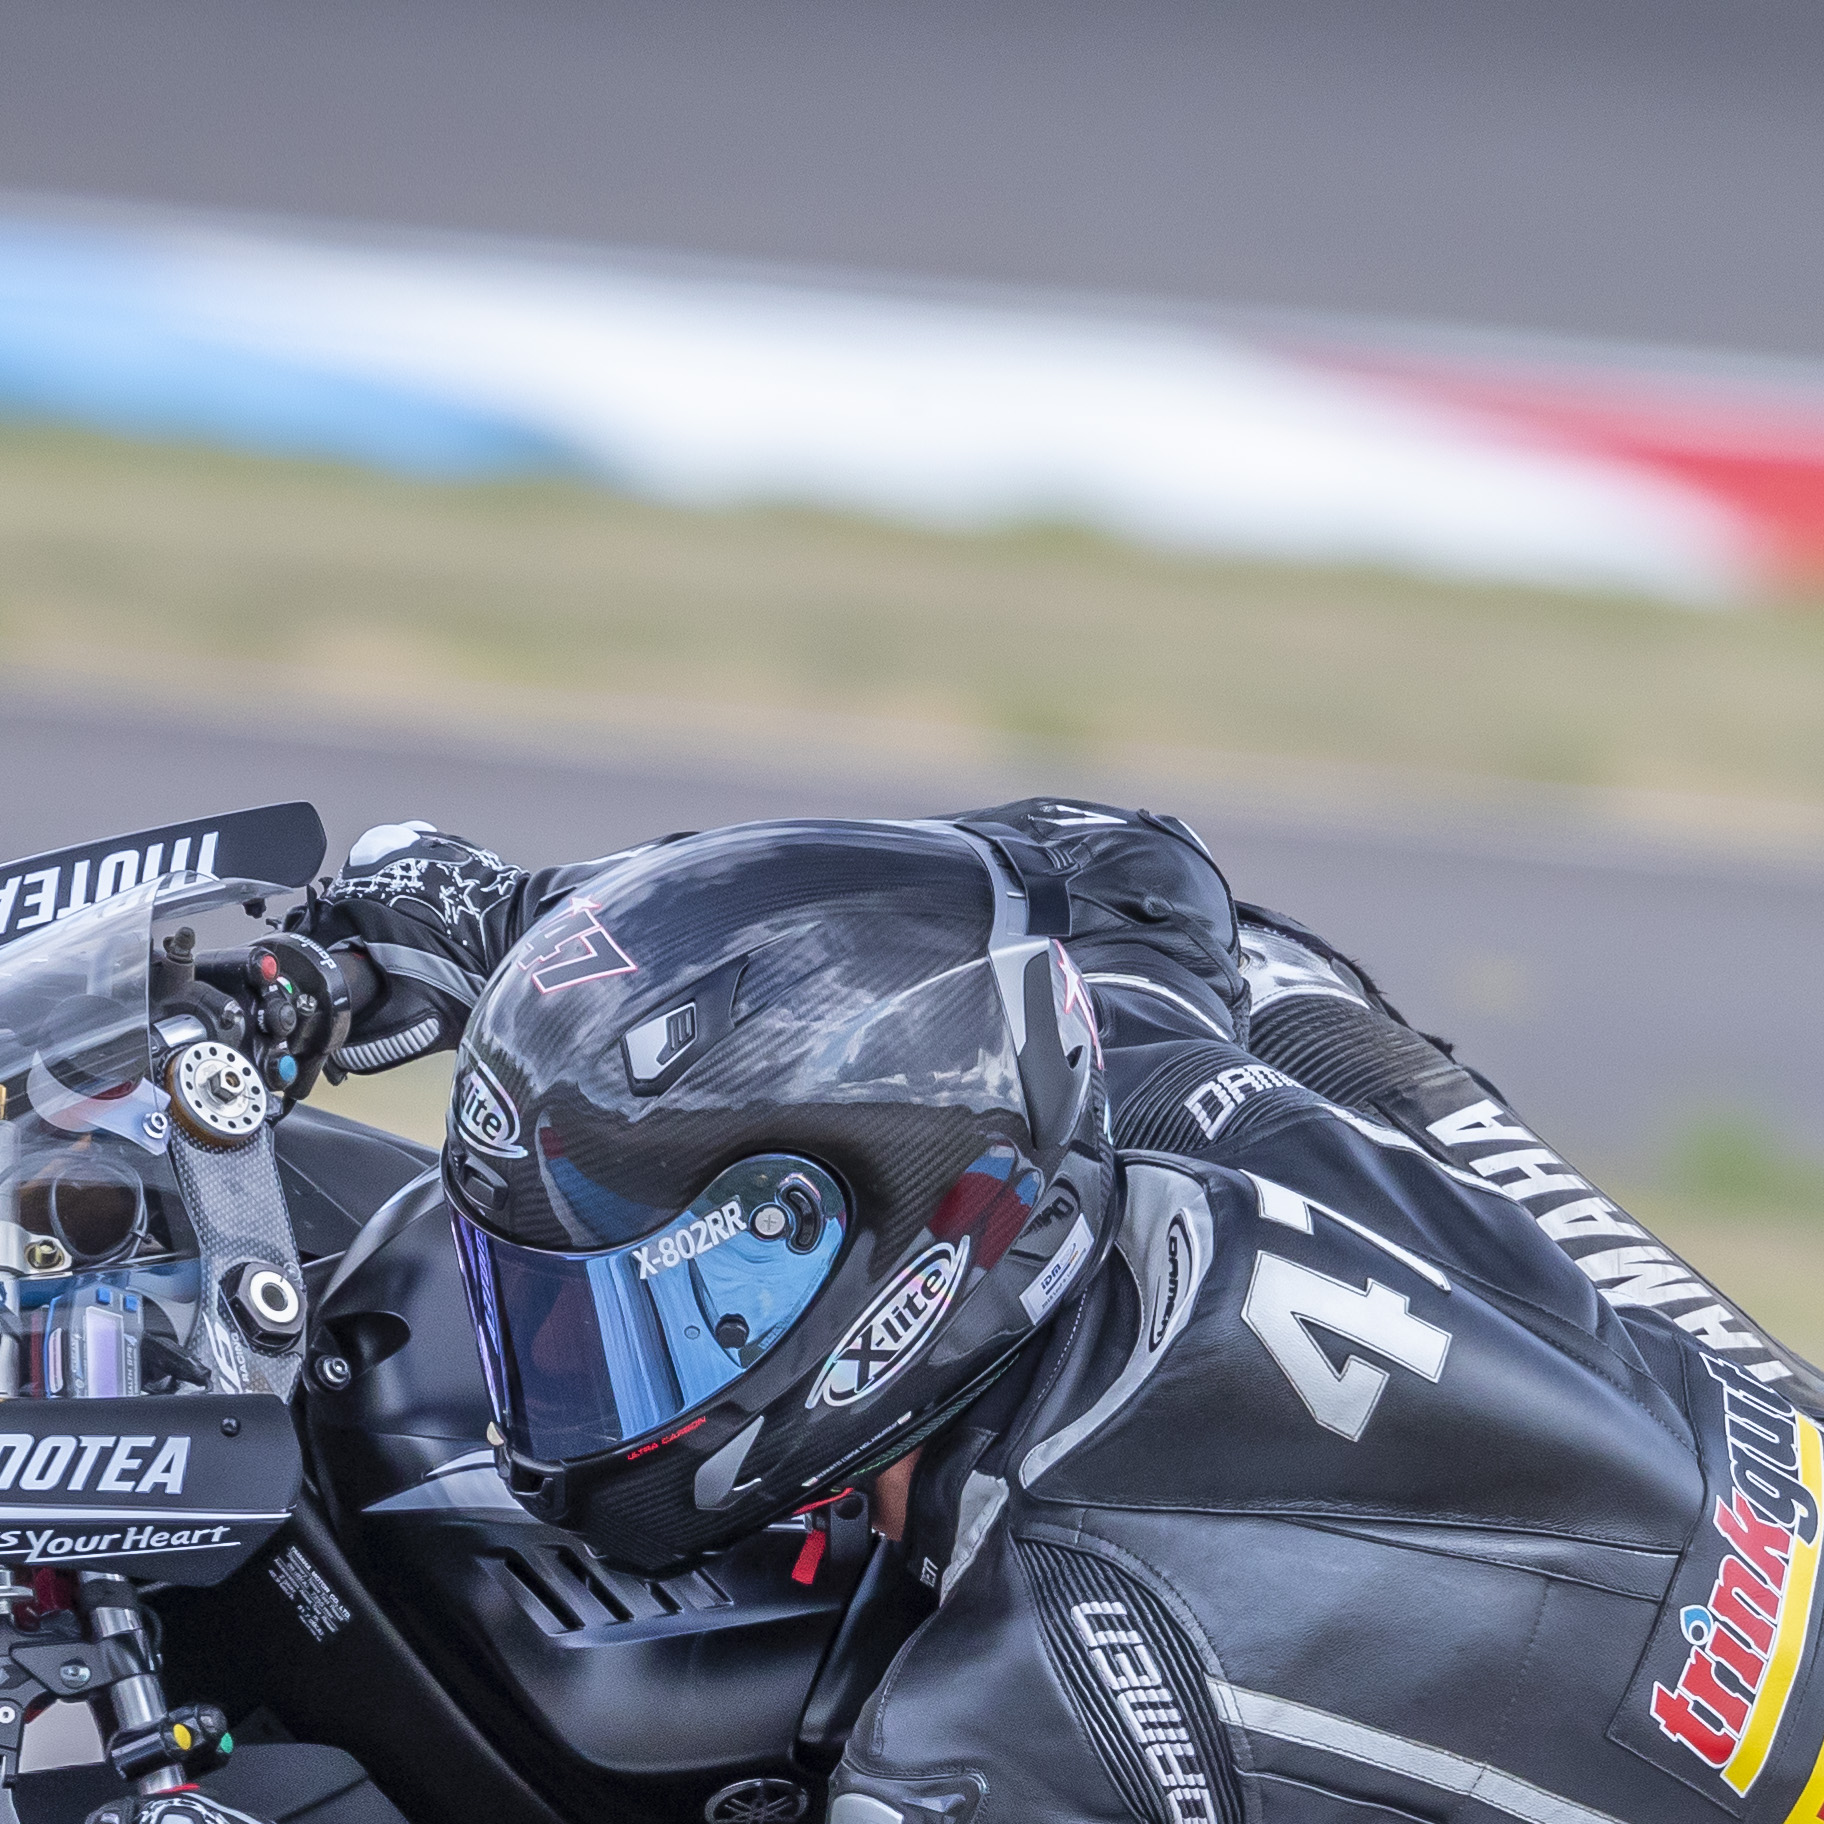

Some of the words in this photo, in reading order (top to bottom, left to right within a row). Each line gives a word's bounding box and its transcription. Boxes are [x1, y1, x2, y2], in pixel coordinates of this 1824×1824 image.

[632, 1200, 748, 1280] X-802RR
[836, 1268, 947, 1394] X-lite
[25, 1529, 122, 1563] Your
[122, 1525, 231, 1550] Heart
[1650, 1351, 1817, 1770] trinkgut
